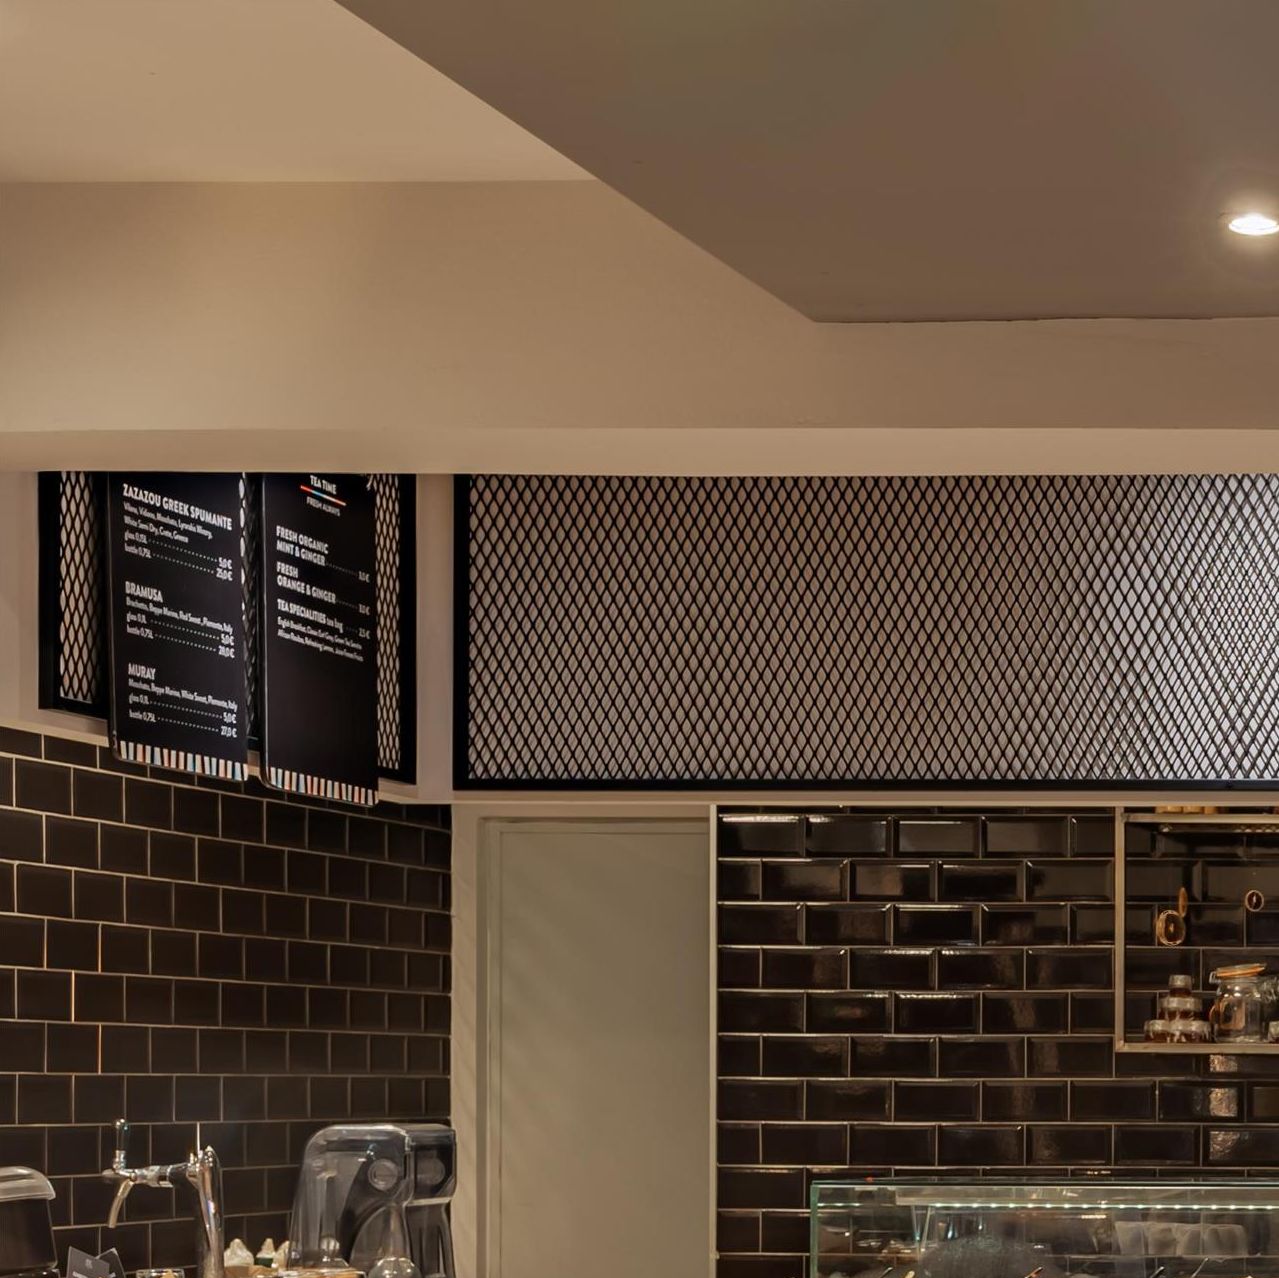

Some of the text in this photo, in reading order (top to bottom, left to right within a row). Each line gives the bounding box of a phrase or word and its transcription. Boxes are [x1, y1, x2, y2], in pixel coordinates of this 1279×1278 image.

[310, 475, 337, 495] TEA TIME
[122, 483, 232, 531] ZAZAZOU GREEK SPUMANTE
[276, 525, 329, 555] FRESH ORGANIC
[276, 540, 294, 556] MINT
[294, 546, 300, 558] &
[300, 548, 326, 567] GINGER
[276, 561, 299, 579] FRESH
[125, 581, 164, 603] BRAMUSA
[277, 575, 305, 594] ORANGE
[306, 584, 311, 596] &
[311, 586, 336, 604] GINGER
[277, 598, 289, 612] TEA
[289, 602, 326, 625] SPECIALITIES
[128, 662, 156, 680] MURAY
